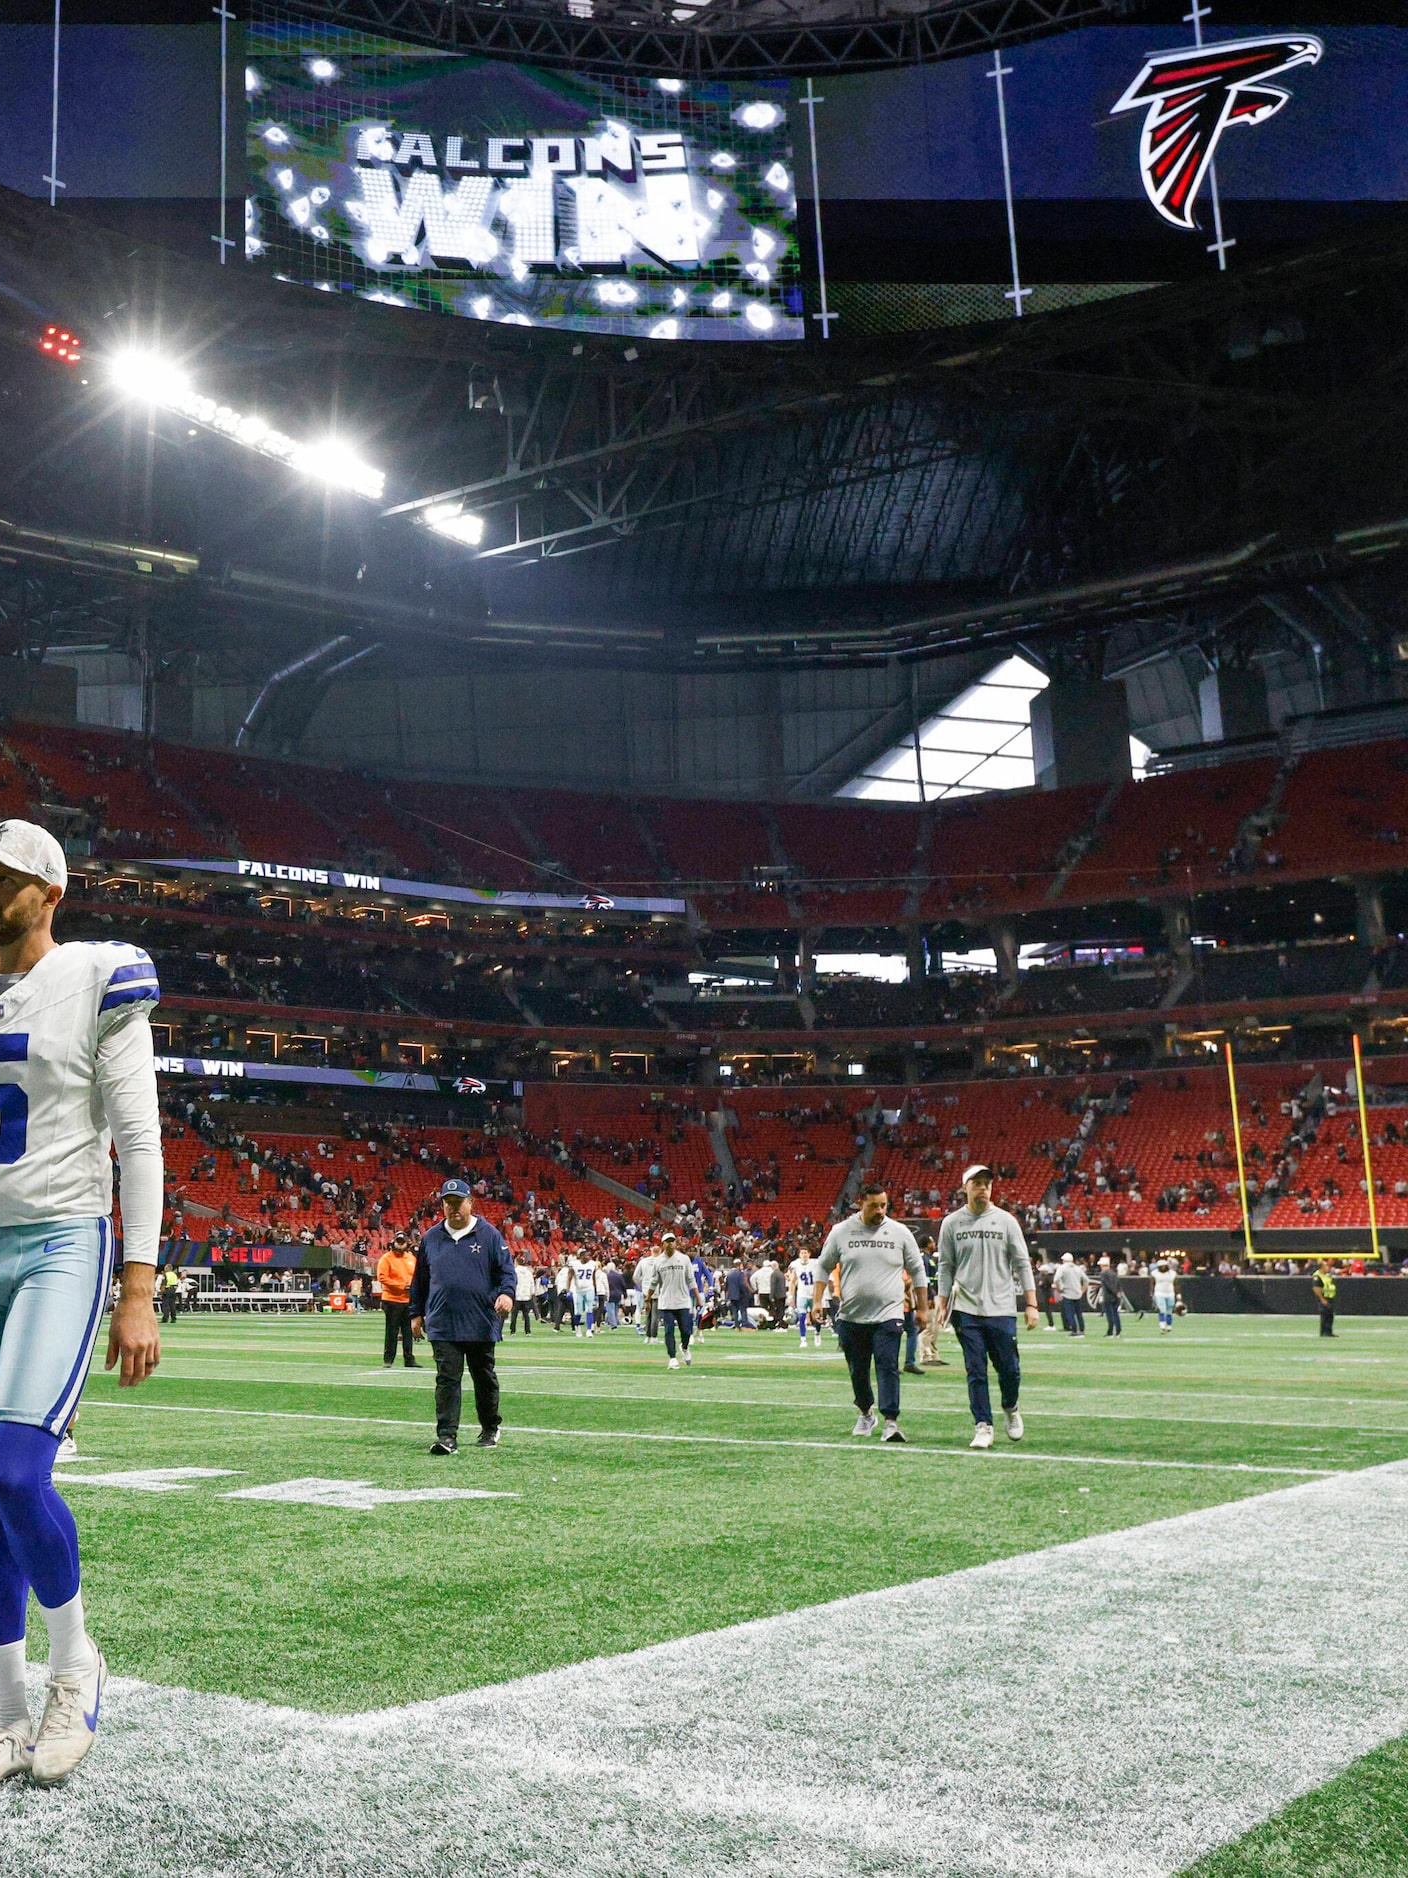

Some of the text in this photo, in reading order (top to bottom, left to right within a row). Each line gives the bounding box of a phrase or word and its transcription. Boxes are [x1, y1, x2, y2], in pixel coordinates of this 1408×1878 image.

[356, 131, 687, 170] FALCONS
[355, 167, 700, 268] WIN
[238, 860, 380, 891] FALCONS WIN
[202, 1059, 244, 1077] WIN
[848, 1240, 896, 1250] COWBOYS
[956, 1231, 1004, 1241] COWBOYS
[211, 1246, 274, 1264] RSE UP
[577, 1268, 593, 1280] 76
[799, 1271, 814, 1286] 91
